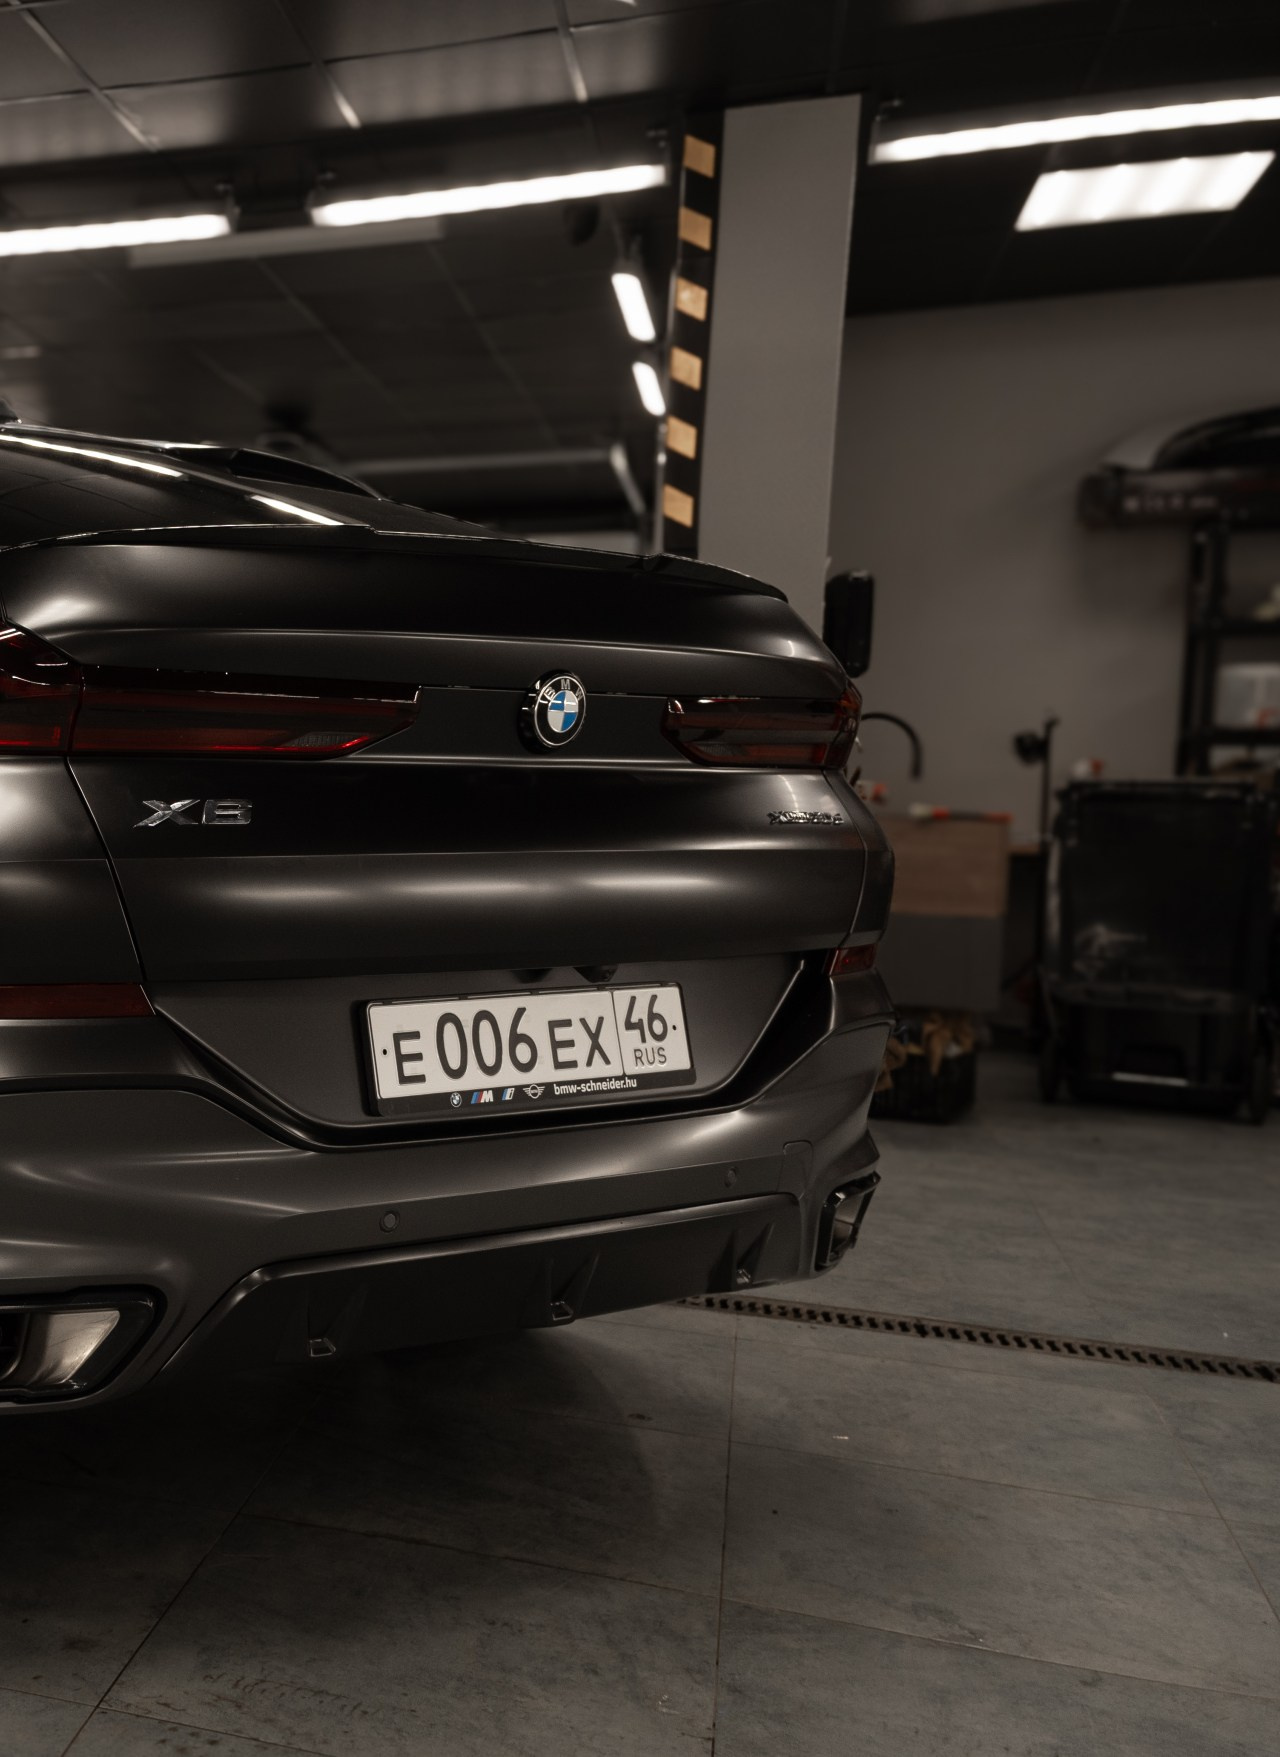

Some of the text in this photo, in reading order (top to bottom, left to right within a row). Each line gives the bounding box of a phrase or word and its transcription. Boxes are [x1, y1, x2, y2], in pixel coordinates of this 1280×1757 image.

[544, 679, 583, 701] BMW
[624, 994, 668, 1044] 46
[634, 1047, 667, 1067] RUS
[554, 1077, 637, 1095] bmw-schneider.hu
